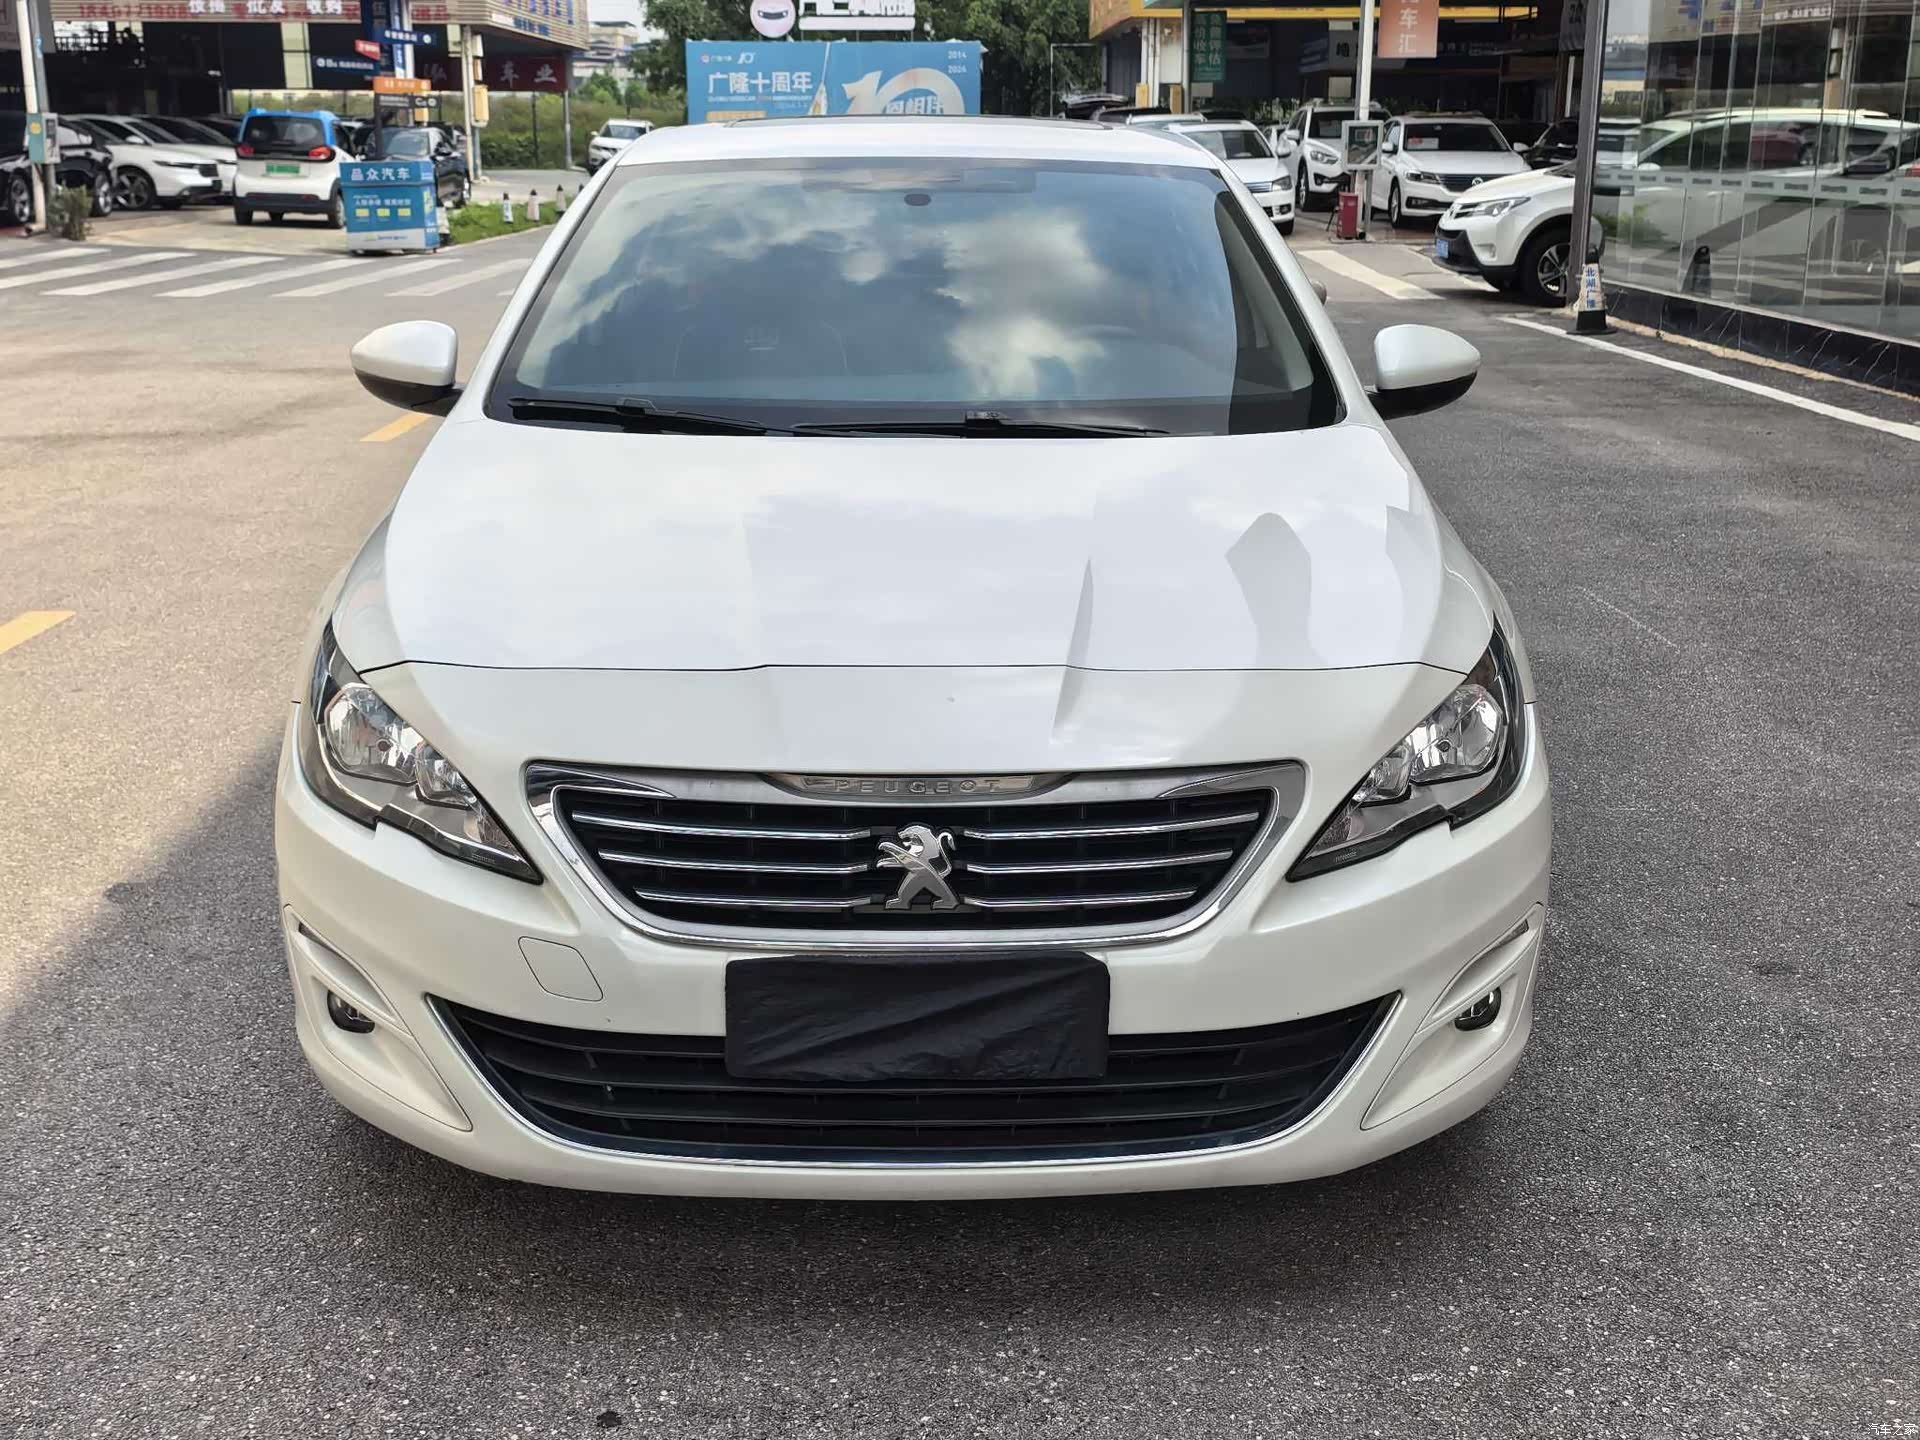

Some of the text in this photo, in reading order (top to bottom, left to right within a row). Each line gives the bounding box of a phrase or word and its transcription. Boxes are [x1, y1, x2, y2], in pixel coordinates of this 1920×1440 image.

[708, 71, 813, 94] 广隆十周年
[834, 778, 1002, 793] PEUGEOT
